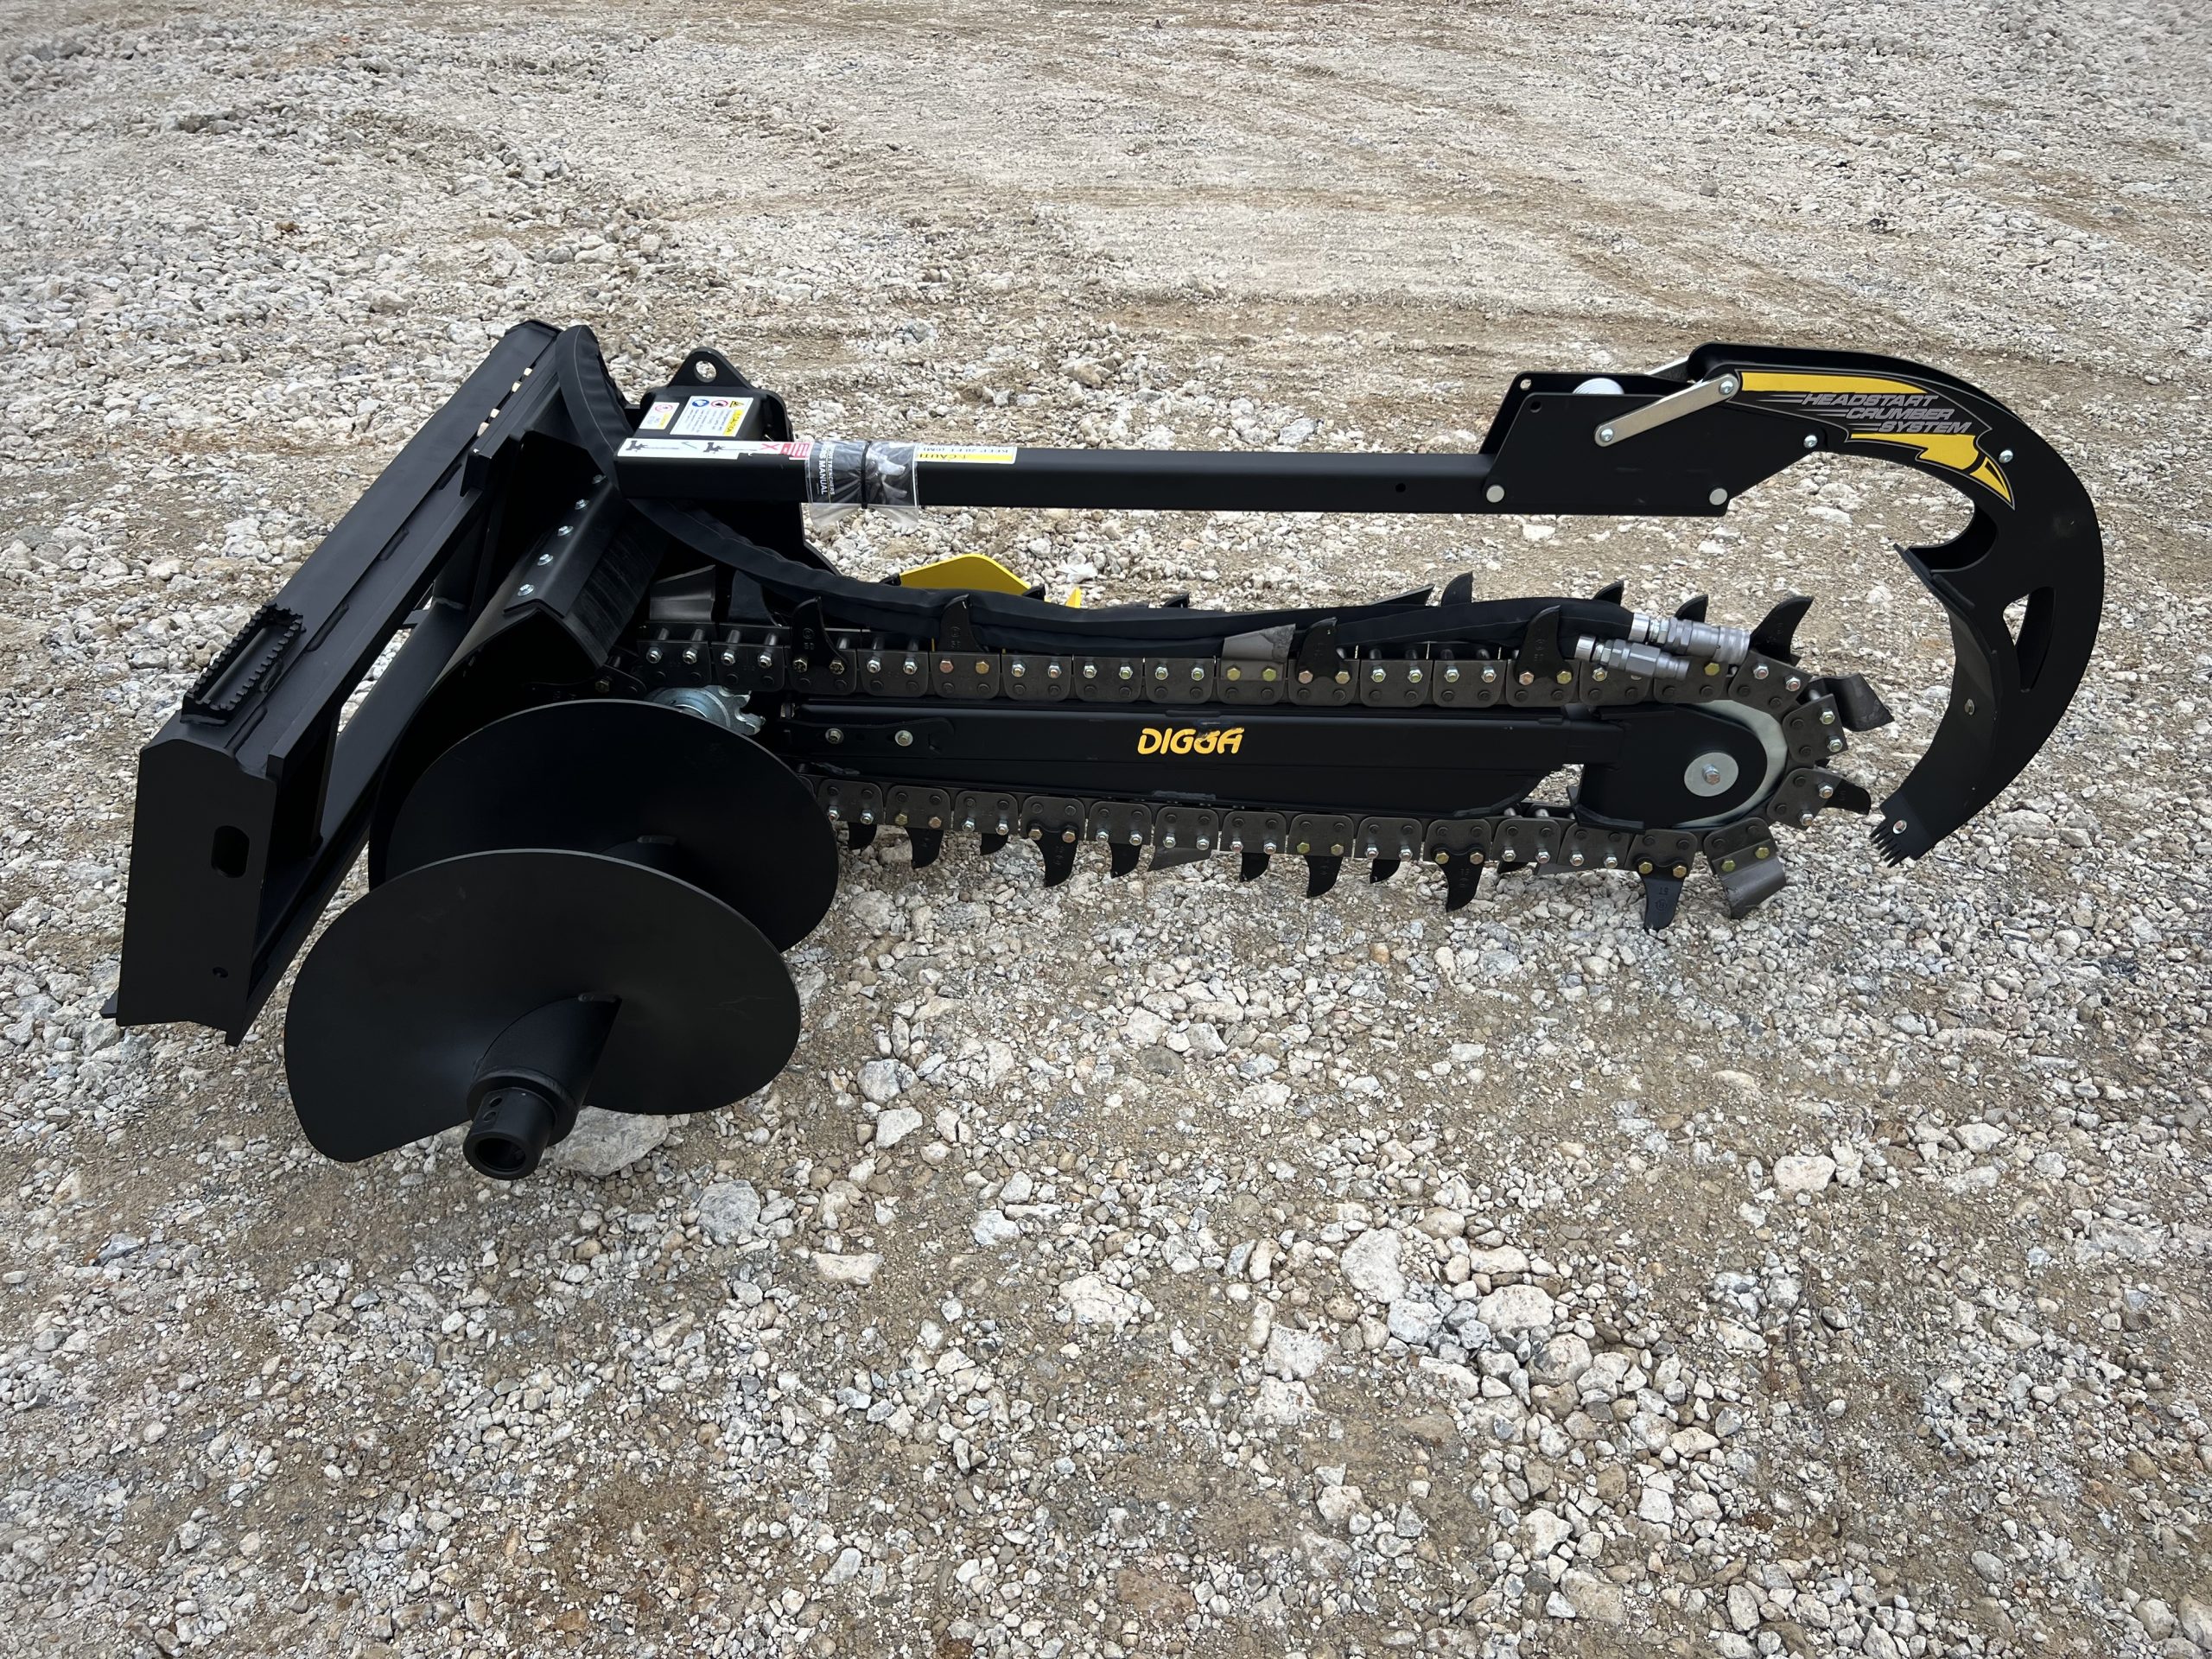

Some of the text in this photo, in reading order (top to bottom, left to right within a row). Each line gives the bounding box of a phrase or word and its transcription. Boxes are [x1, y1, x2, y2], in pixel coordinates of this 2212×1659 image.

[1802, 394, 1939, 407] HEADSTART
[1846, 409, 1955, 420] CRUMBER
[1878, 422, 1973, 434] SYSTEM
[819, 460, 828, 495] MANUAL
[1137, 728, 1245, 755] DIGGA
